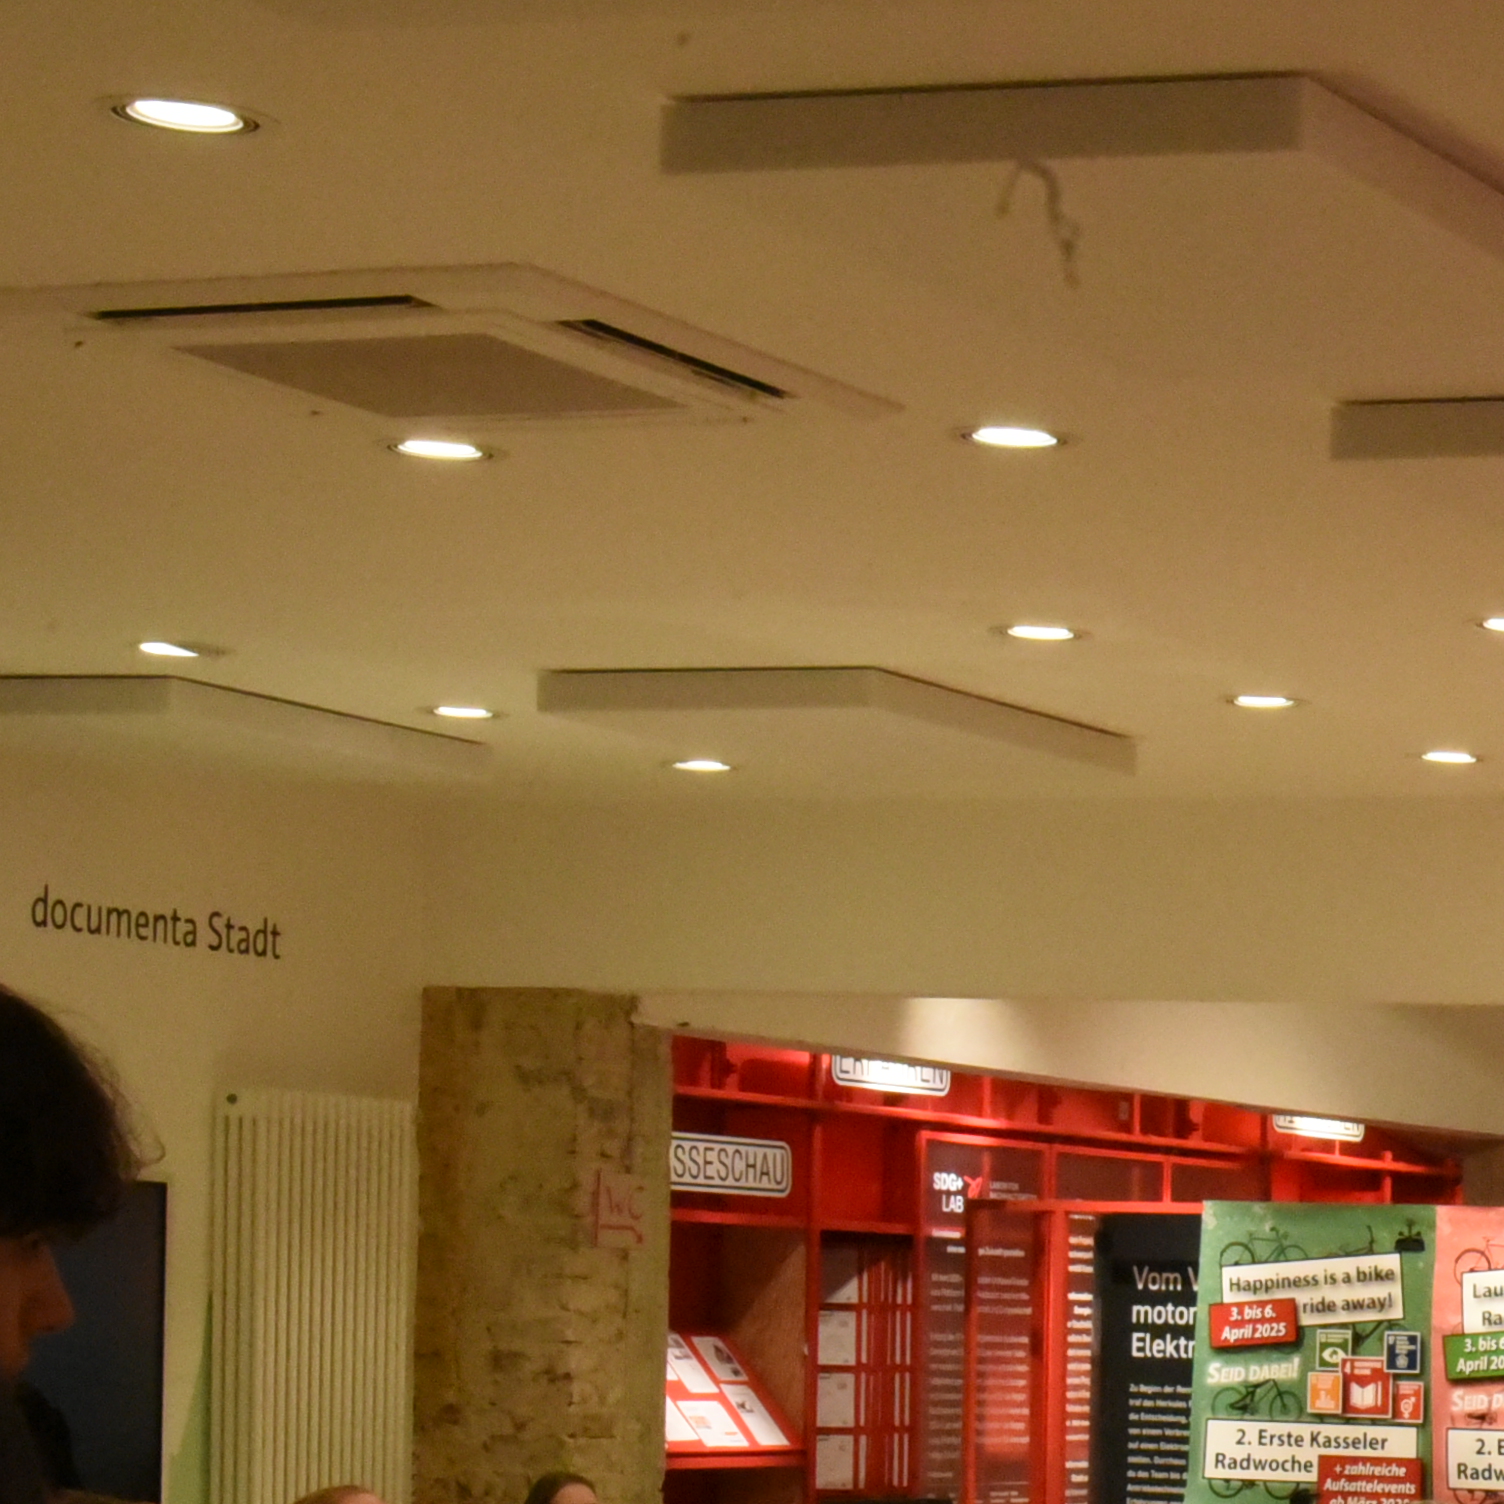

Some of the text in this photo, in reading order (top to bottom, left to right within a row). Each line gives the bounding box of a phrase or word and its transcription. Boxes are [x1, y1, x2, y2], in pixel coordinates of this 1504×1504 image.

[31, 884, 282, 960] documenta Stadt
[942, 1194, 964, 1212] LAB
[1132, 1265, 1182, 1291] Vom
[1229, 1265, 1395, 1295] Happiness is a bike
[1229, 1304, 1276, 1321] 3. bis 6.
[1303, 1292, 1392, 1314] ride away!
[1132, 1302, 1198, 1326] motor
[1221, 1322, 1287, 1342] April 2025
[1131, 1332, 1196, 1359] Elektr
[1463, 1338, 1476, 1352] 3.
[1478, 1336, 1497, 1351] bis
[1456, 1356, 1487, 1374] April
[1235, 1429, 1388, 1450] 2. Erste Kasseler
[1475, 1438, 1492, 1455] 2.
[1215, 1452, 1314, 1474] Radwoche
[1344, 1463, 1407, 1477] zahlreiche
[1324, 1478, 1416, 1494] Aufsattelevents
